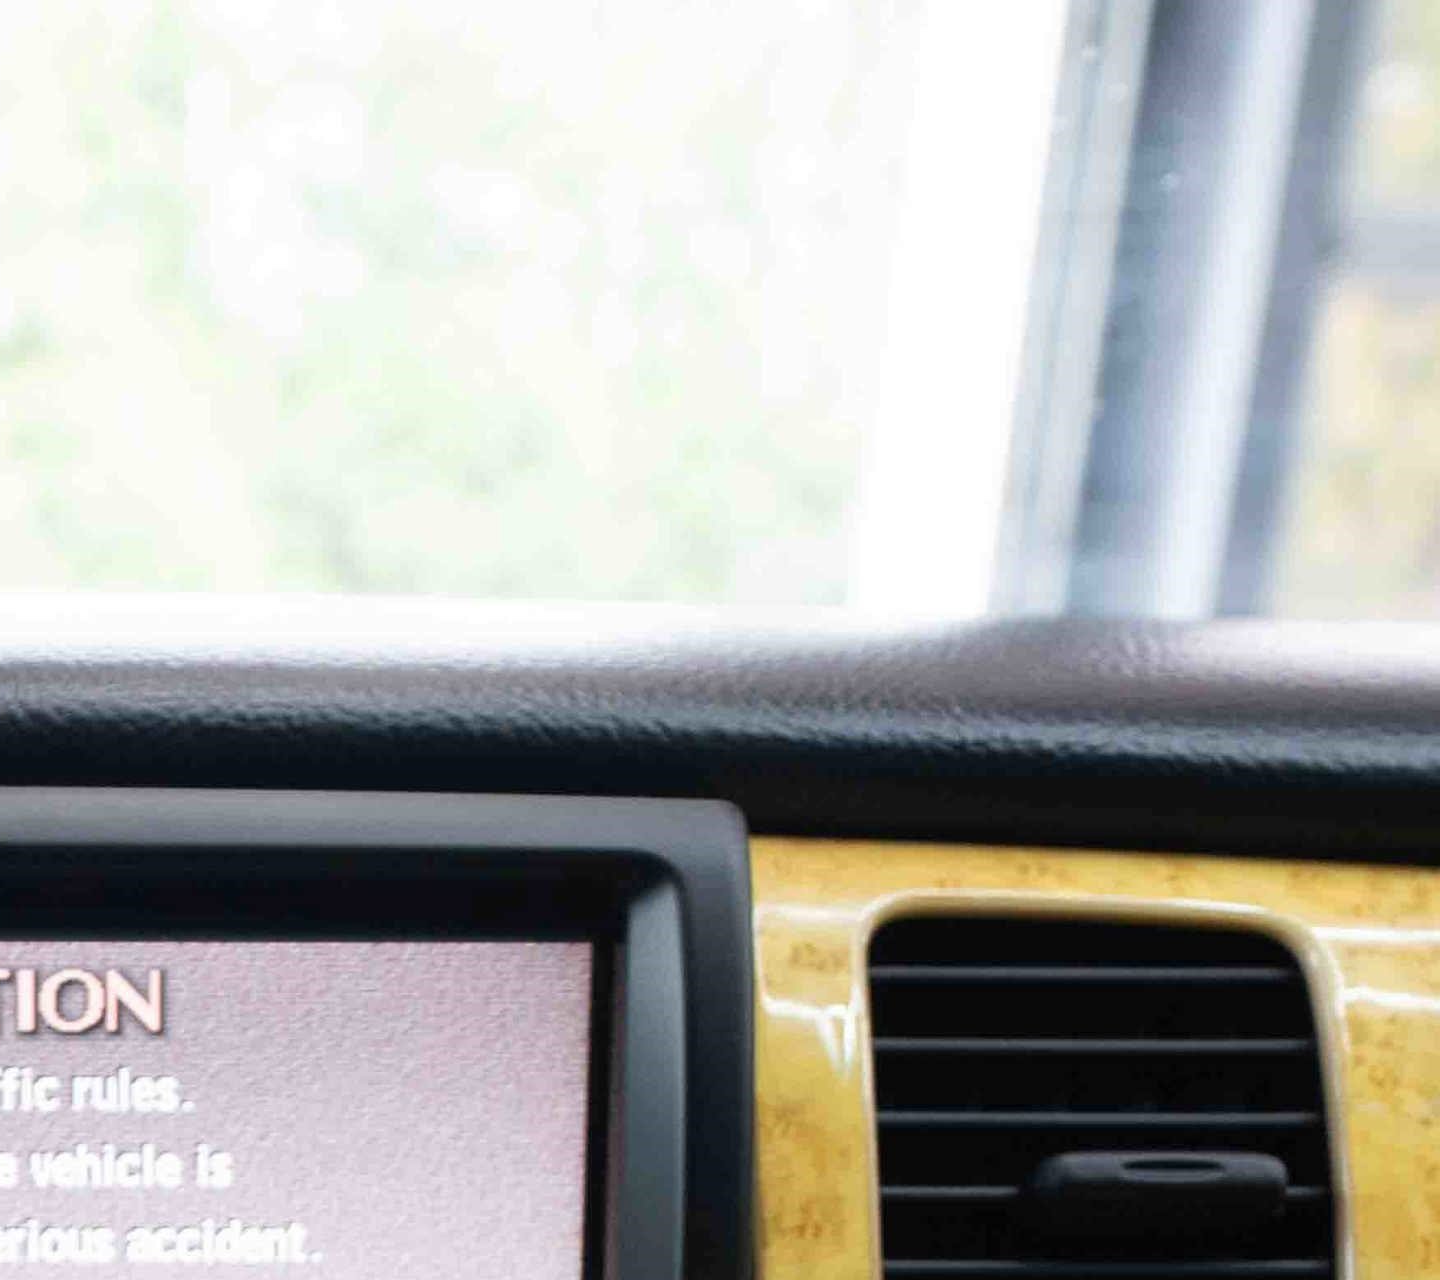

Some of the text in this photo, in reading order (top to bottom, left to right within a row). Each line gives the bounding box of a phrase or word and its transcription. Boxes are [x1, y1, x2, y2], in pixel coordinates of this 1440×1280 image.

[71, 1067, 195, 1112] rules.
[30, 1143, 183, 1187] vehicle
[195, 1143, 235, 1187] is
[126, 1219, 323, 1263] accident.
